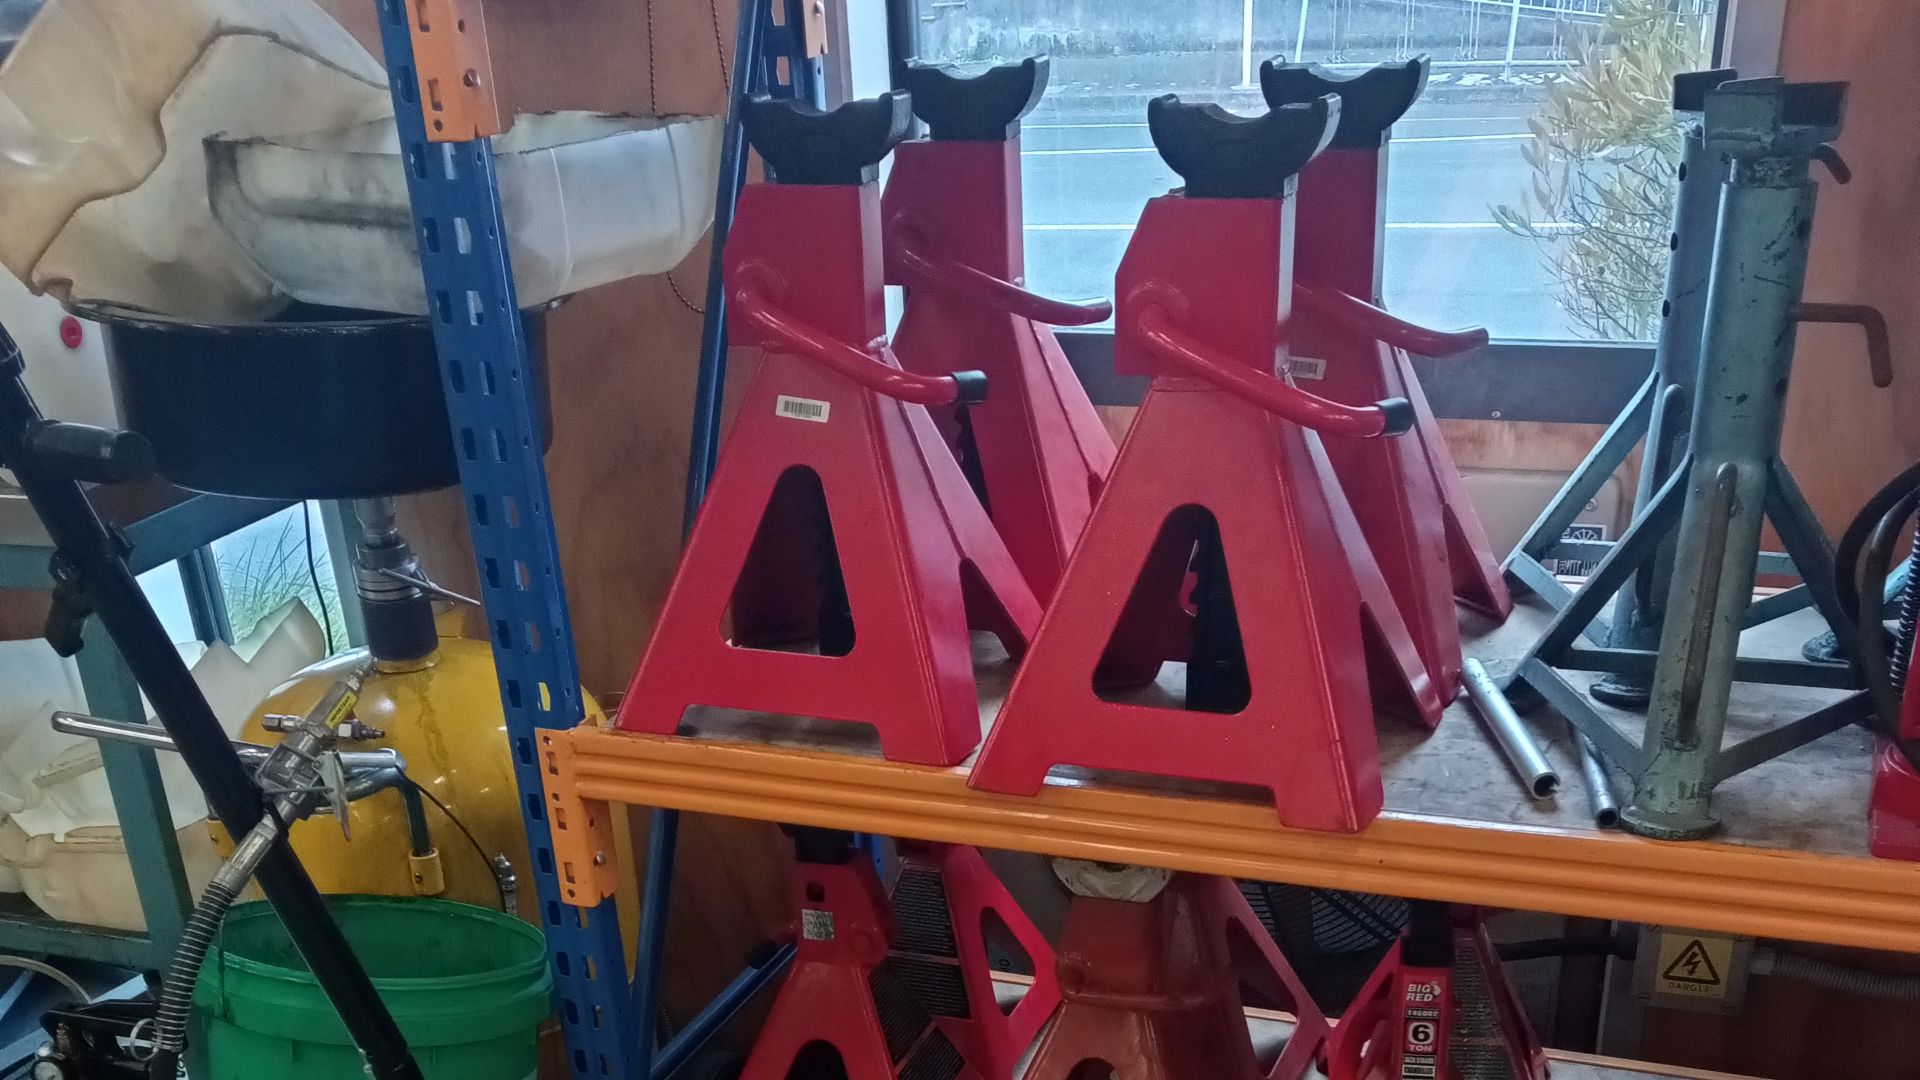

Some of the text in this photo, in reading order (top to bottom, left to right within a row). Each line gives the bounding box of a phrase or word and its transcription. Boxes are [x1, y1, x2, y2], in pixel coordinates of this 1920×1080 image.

[1408, 984, 1431, 993] BIG
[1668, 981, 1711, 992] DANGER
[1406, 993, 1433, 1002] RED
[1412, 1024, 1430, 1042] 6
